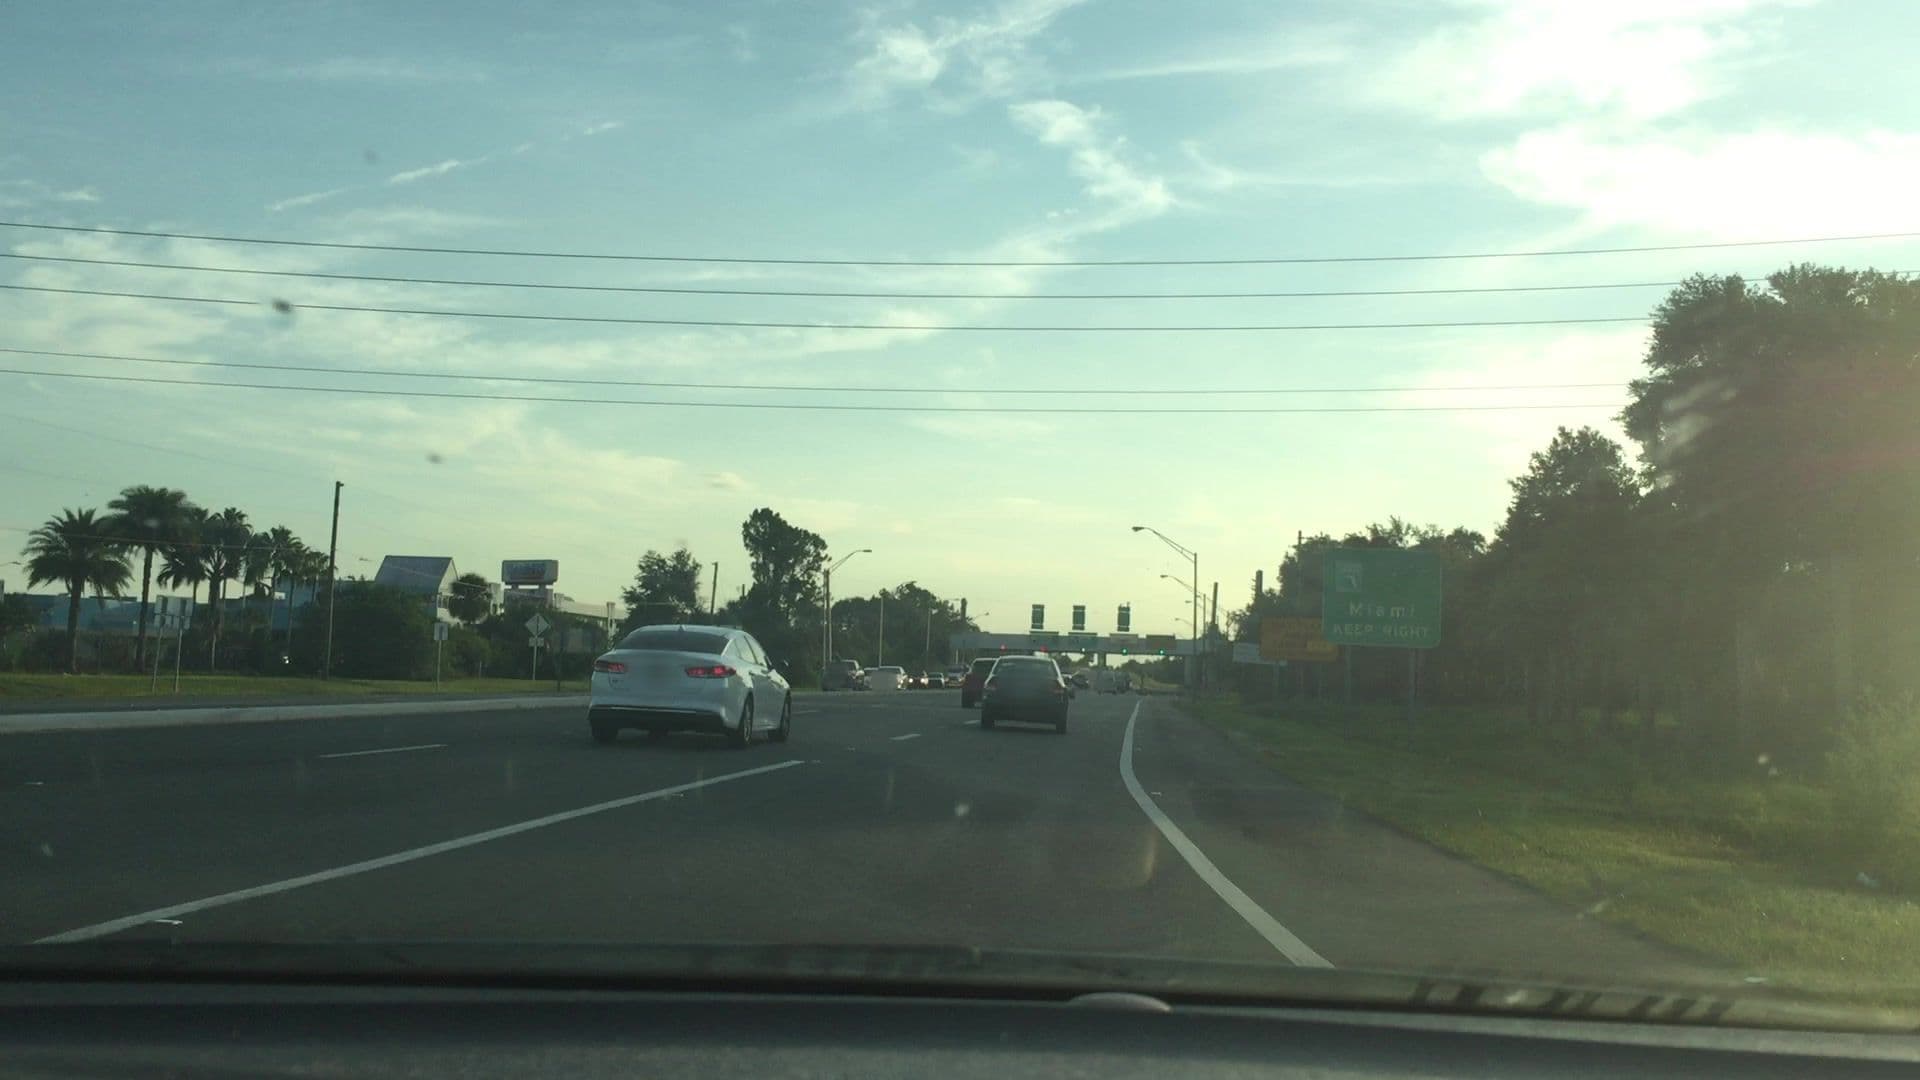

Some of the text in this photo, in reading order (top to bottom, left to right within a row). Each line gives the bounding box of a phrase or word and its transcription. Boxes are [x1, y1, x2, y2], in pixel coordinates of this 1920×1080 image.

[1349, 600, 1415, 617] Miami
[1333, 623, 1375, 637] KEEP
[1382, 624, 1429, 640] RIGHT
